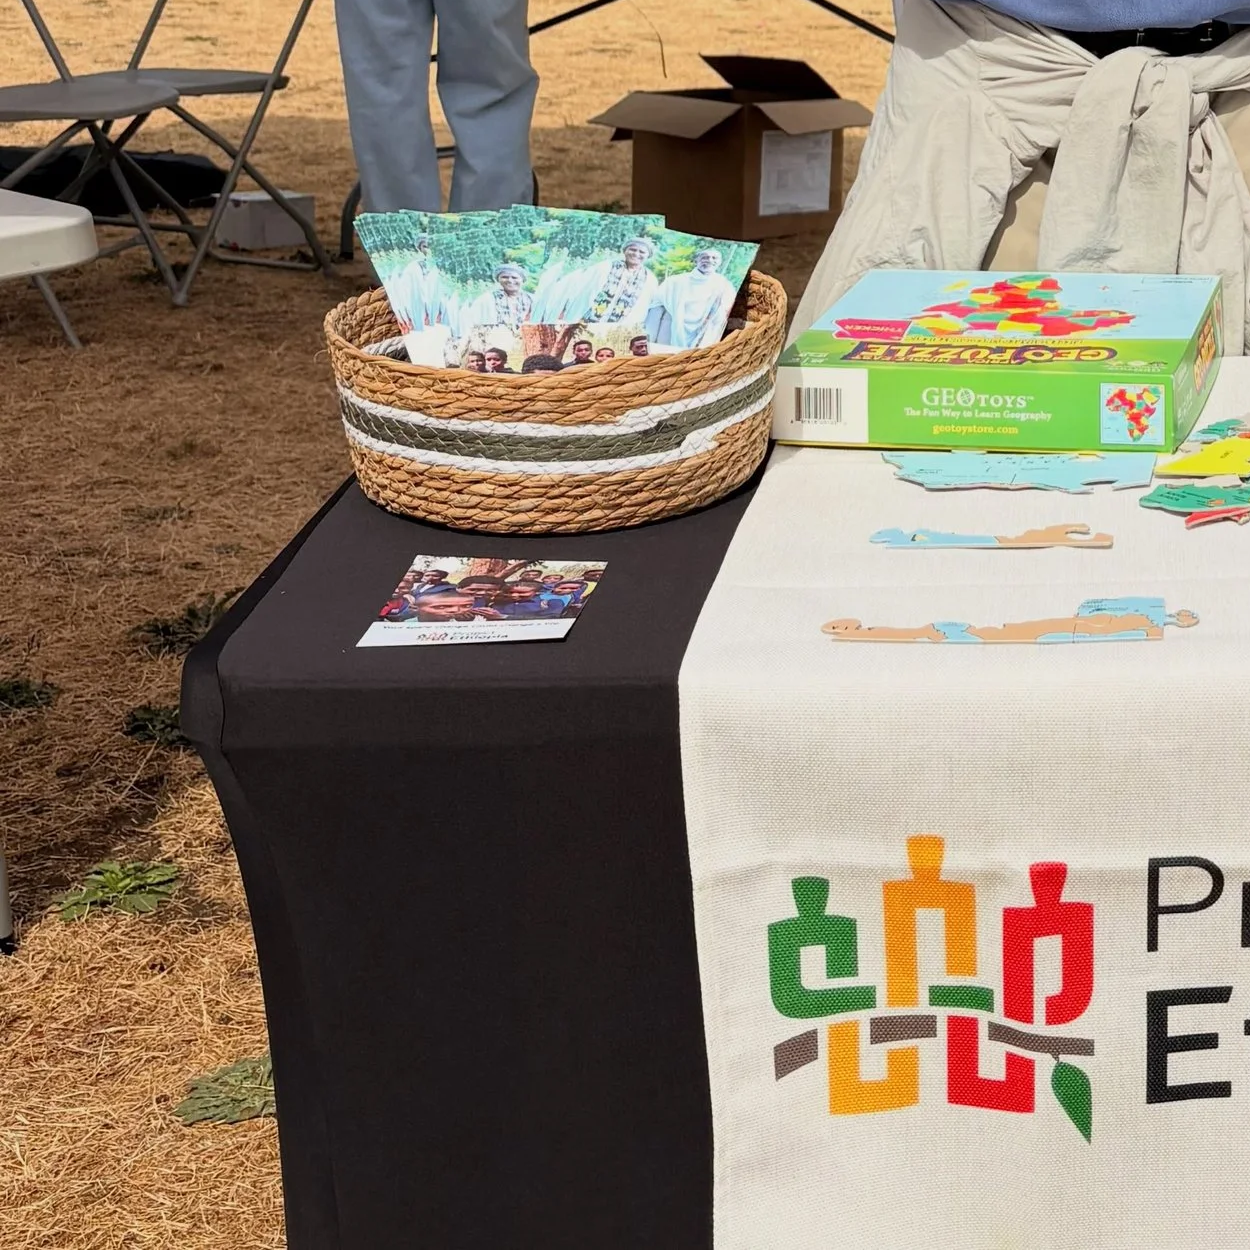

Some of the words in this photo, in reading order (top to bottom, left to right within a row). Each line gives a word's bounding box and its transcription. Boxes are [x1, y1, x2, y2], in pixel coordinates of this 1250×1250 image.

[904, 407, 921, 416] The
[923, 408, 940, 416] Fun
[942, 409, 961, 420] Way
[963, 410, 973, 418] to
[975, 410, 1000, 419] Learn
[1003, 410, 1053, 423] Geography
[932, 424, 1019, 436] geotoystore.com
